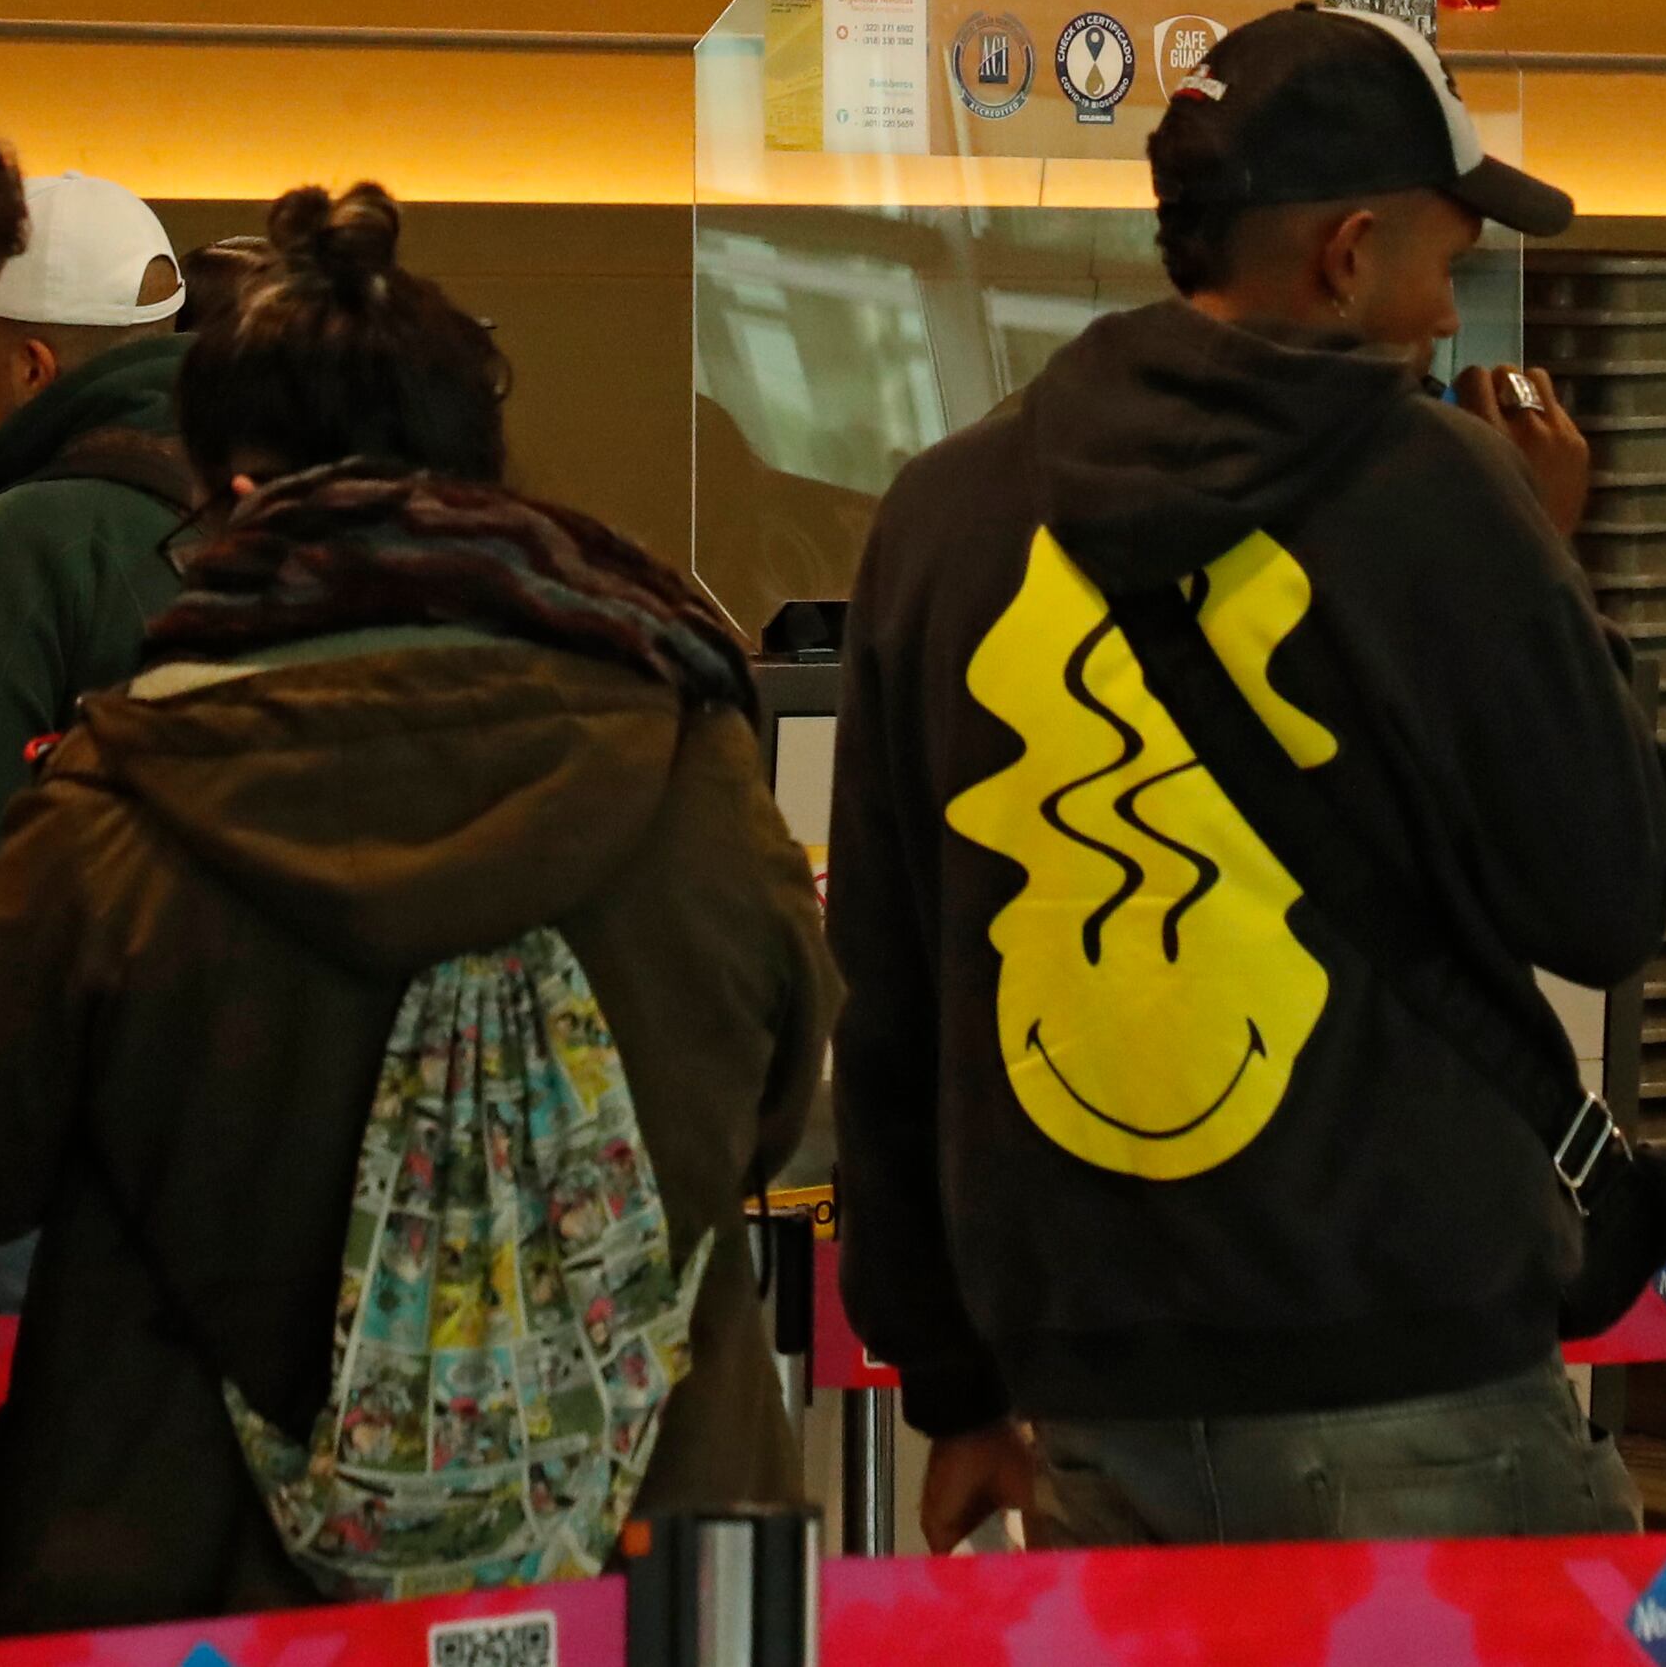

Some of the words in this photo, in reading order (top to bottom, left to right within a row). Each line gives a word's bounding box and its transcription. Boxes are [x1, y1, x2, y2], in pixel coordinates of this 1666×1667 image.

[1057, 25, 1076, 63] CHECK
[1074, 17, 1086, 30] IN
[1086, 14, 1133, 64] CERTIFICADO
[1175, 31, 1207, 50] SAFE
[1170, 49, 1210, 69] GUAR
[1060, 76, 1090, 108] COVID-19
[1091, 77, 1130, 109] BIOSEGURO
[969, 102, 1019, 118] ACCREDITED
